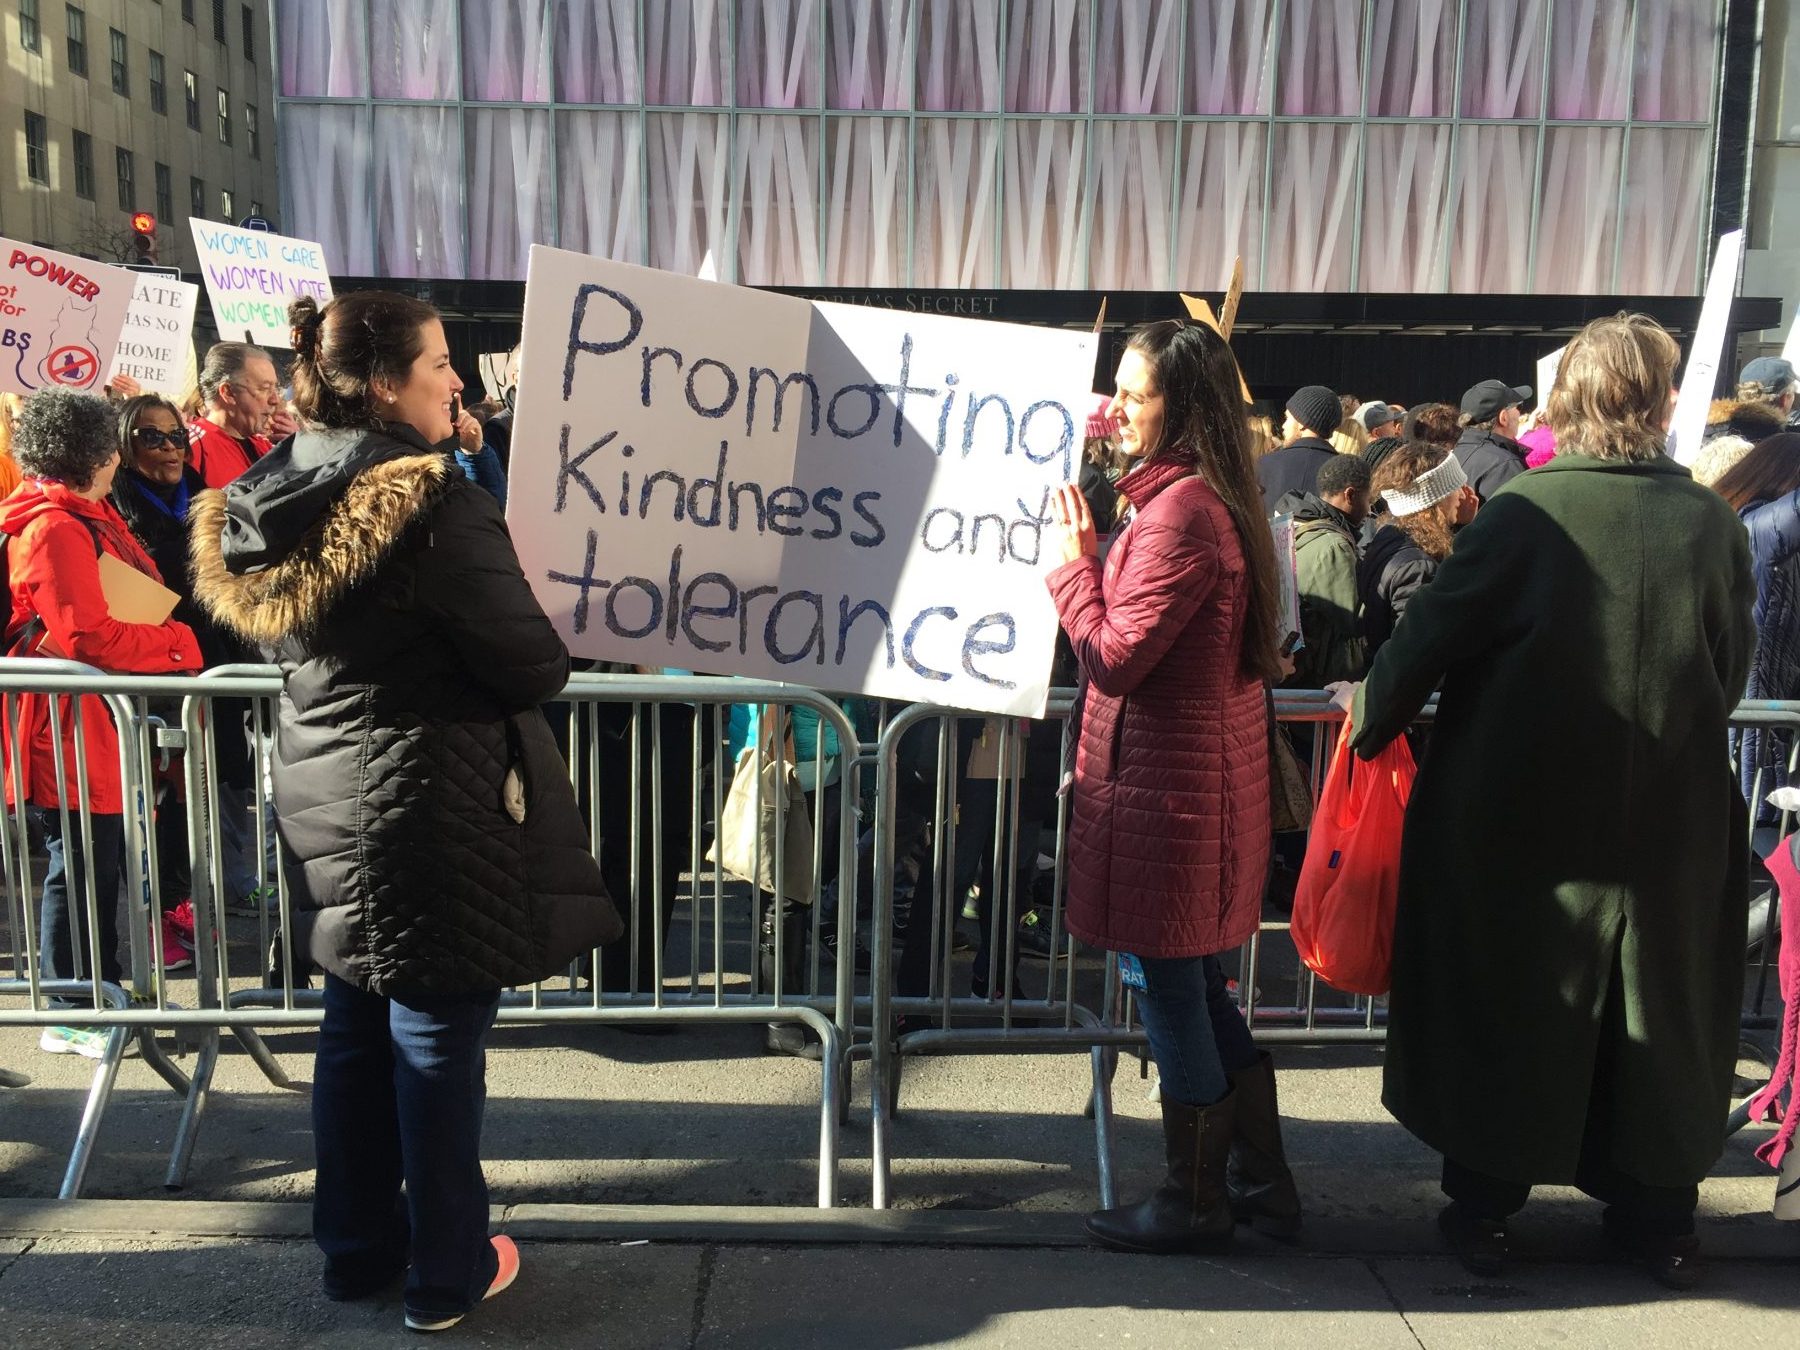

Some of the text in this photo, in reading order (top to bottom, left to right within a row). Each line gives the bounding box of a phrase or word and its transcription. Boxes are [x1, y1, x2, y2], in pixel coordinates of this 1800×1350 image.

[200, 229, 319, 270] WOMEN CARE
[9, 249, 100, 302] POWER
[209, 264, 326, 301] WOMEN VOTE
[131, 285, 182, 308] ATE
[905, 293, 999, 314] SECRET
[156, 317, 179, 332] NO
[218, 301, 287, 328] WOMEN
[2, 328, 31, 350] BS
[117, 341, 171, 361] HOME
[119, 363, 166, 382] HERE
[563, 283, 1075, 481] Promoting
[553, 424, 1053, 565] Kindness and
[547, 528, 1017, 689] tolerance
